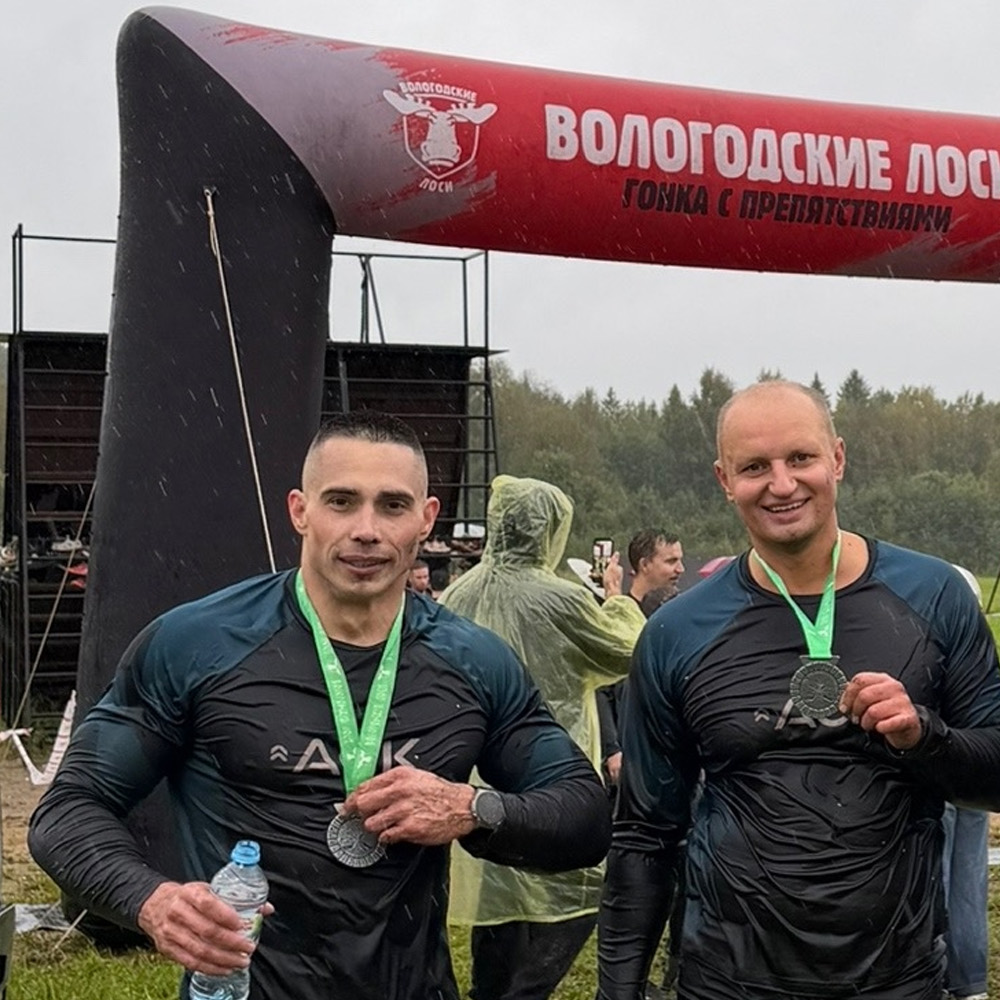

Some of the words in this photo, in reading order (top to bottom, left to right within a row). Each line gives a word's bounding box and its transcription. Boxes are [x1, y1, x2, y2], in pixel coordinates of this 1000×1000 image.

[399, 81, 477, 102] ВОЛОГОДСКИЕ
[545, 104, 892, 191] ВОЛОГОДСКИЕ
[419, 178, 453, 193] ЛОСИ
[622, 178, 708, 216] ГОНКА
[718, 188, 733, 217] С
[739, 189, 953, 233] ПРЕПЯТСТВИЯМИ
